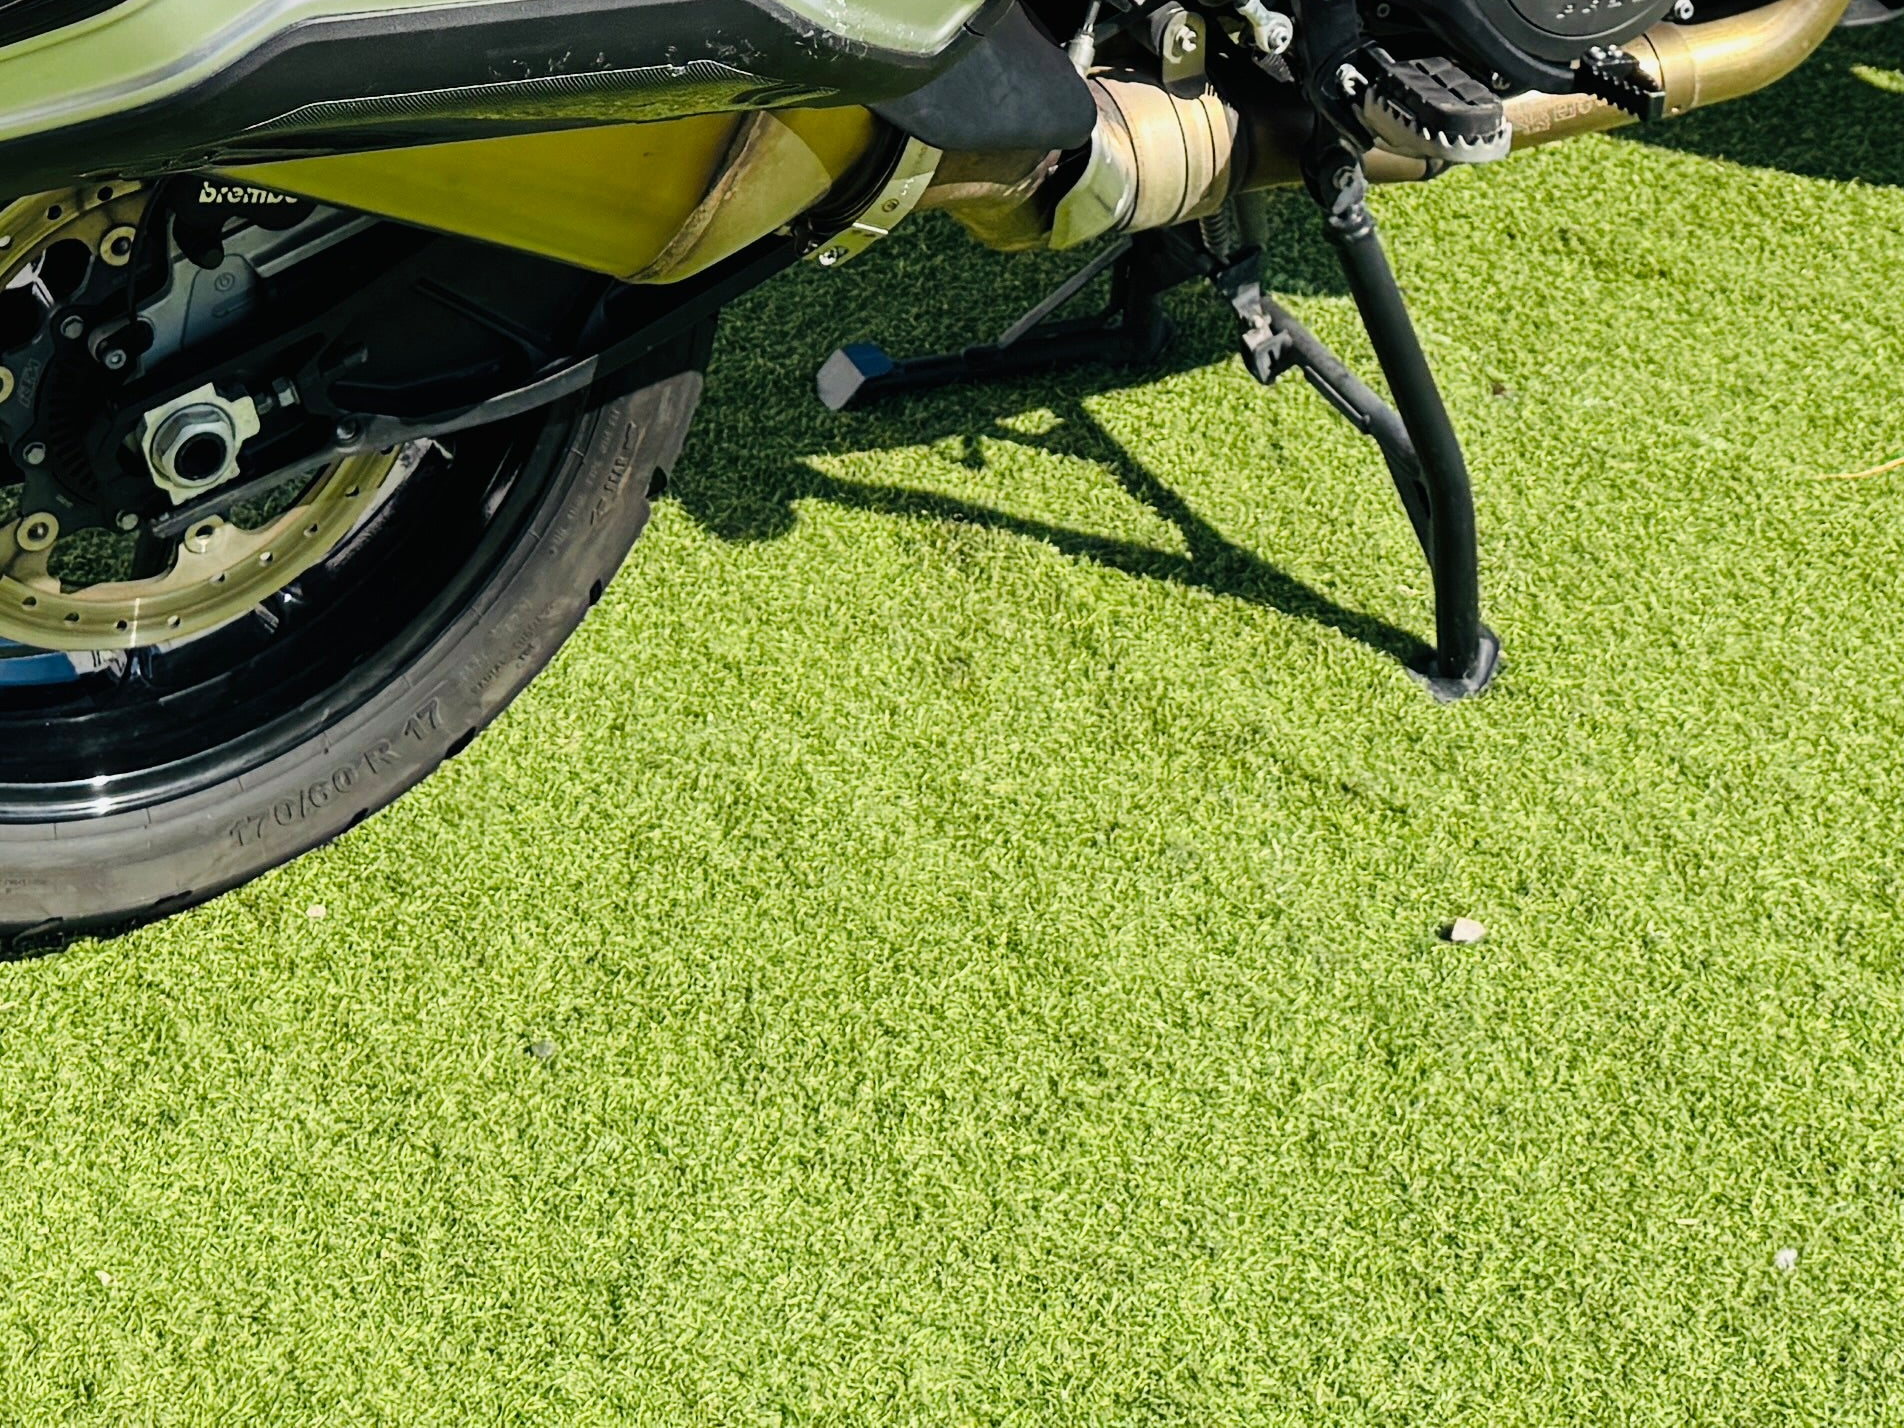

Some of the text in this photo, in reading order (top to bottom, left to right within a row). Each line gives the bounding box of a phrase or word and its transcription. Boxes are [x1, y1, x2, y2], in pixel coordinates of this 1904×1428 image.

[199, 180, 298, 204] brem
[228, 766, 358, 847] 170/60
[404, 697, 442, 741] 17
